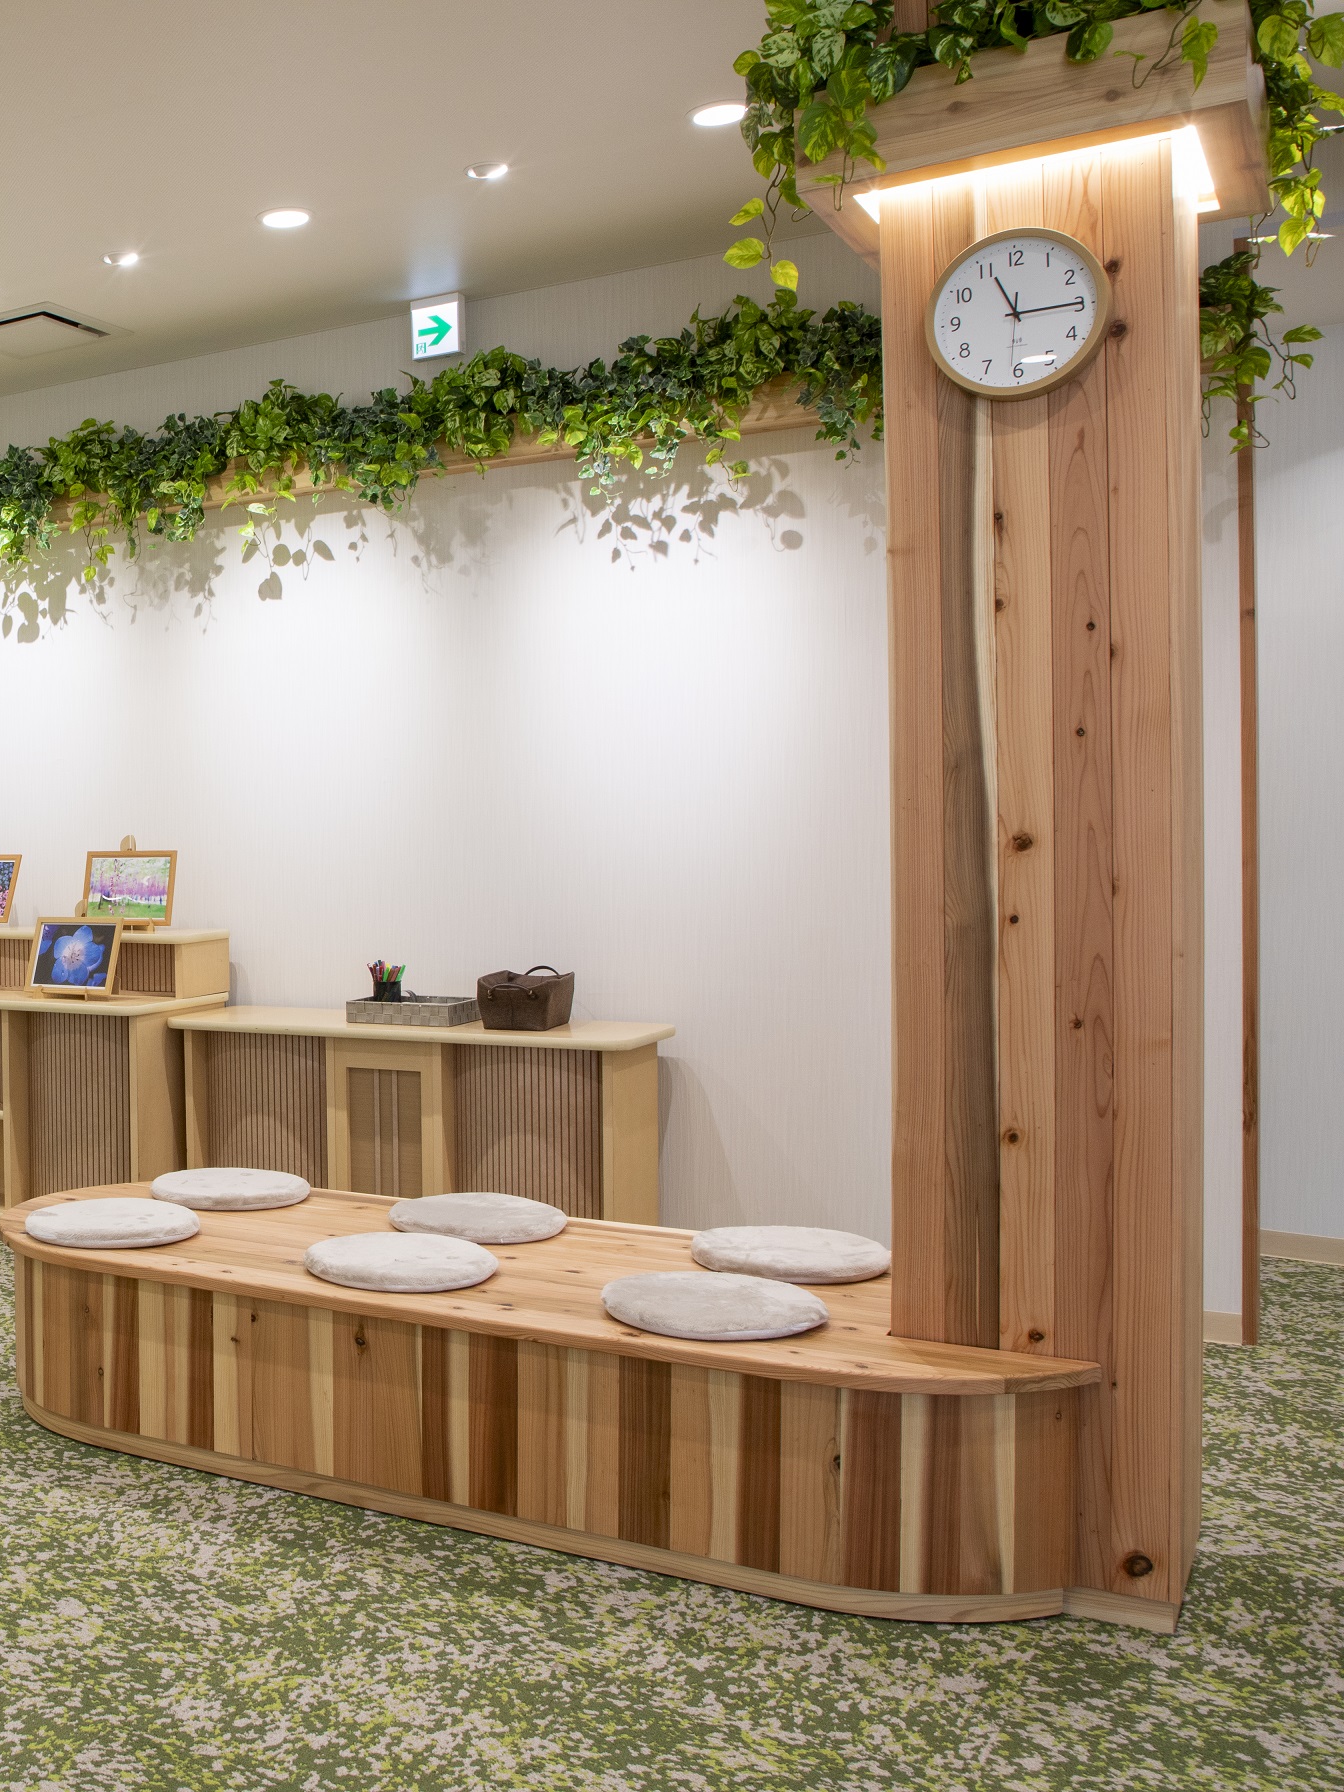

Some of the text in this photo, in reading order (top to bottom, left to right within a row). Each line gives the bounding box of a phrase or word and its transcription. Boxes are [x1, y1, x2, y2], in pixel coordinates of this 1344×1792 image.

[1008, 250, 1024, 267] 12
[979, 262, 992, 279] 11
[1064, 269, 1076, 285] 2
[956, 287, 972, 304] 10
[1074, 296, 1085, 312] 3
[950, 316, 961, 332] 9
[1066, 325, 1078, 341] 4
[959, 343, 970, 358] 8
[982, 359, 992, 375] 7
[1013, 362, 1024, 378] 6
